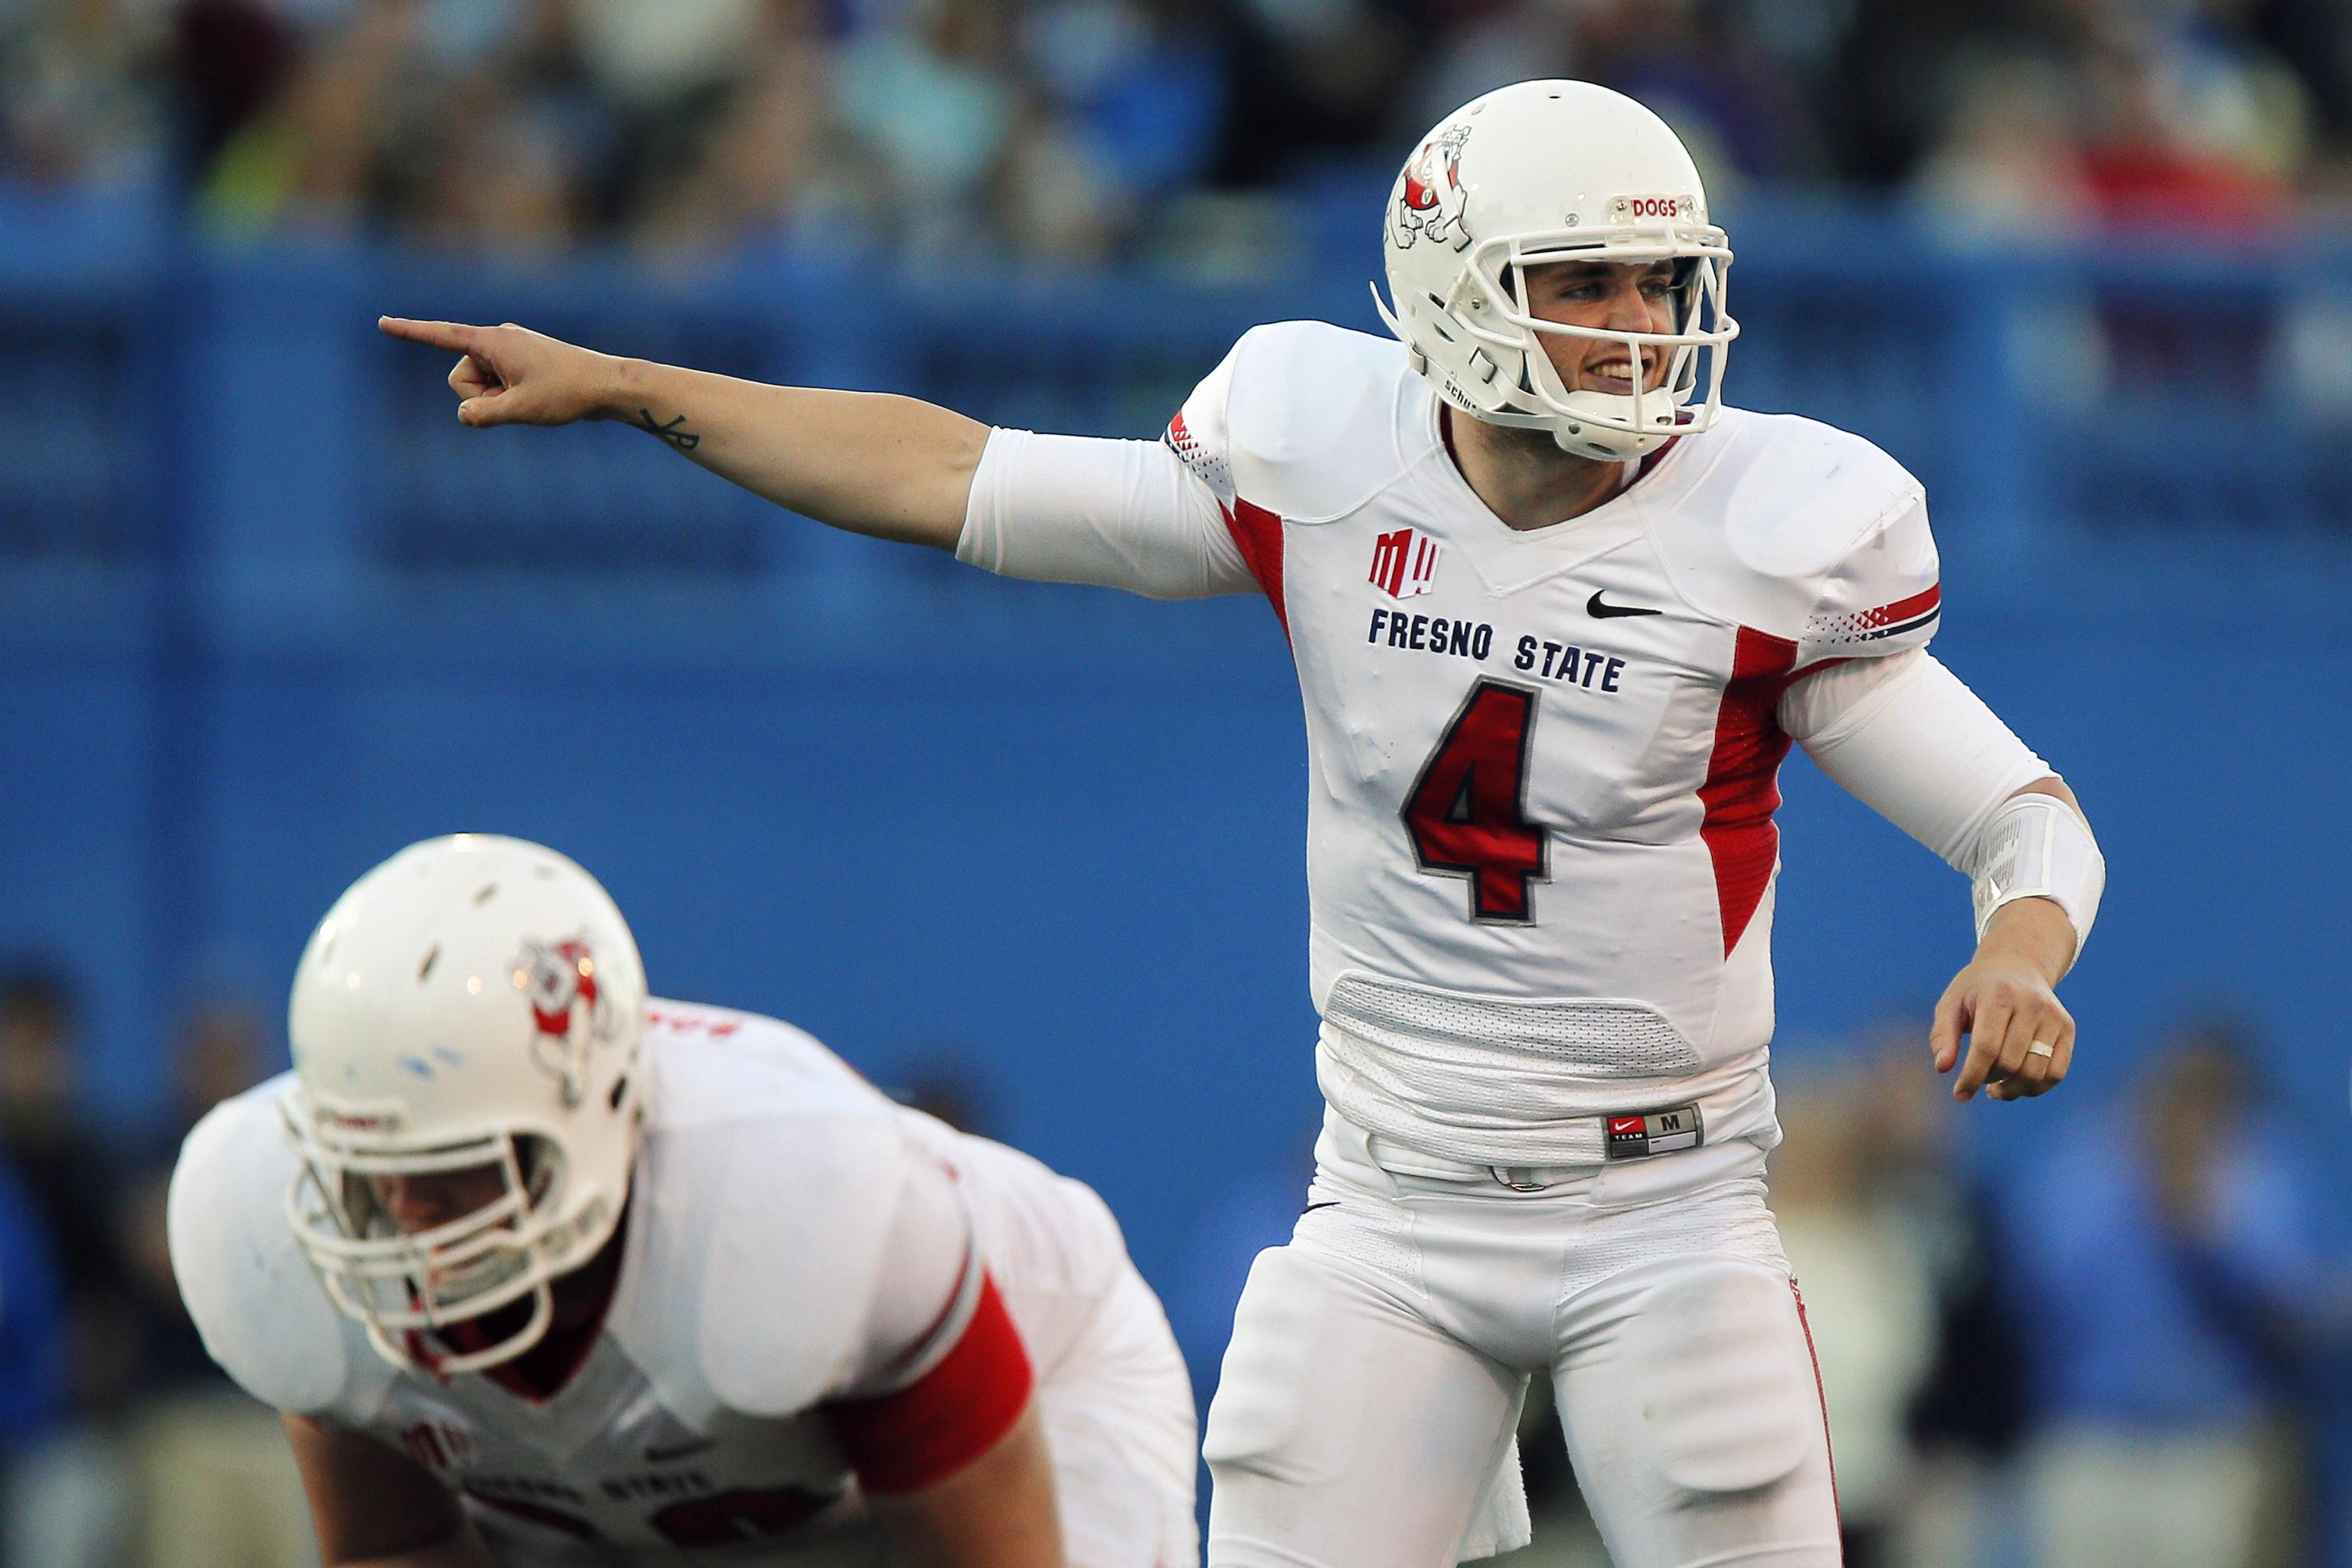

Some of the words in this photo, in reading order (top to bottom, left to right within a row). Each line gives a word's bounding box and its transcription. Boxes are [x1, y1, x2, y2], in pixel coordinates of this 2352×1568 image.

[1369, 609, 1493, 661] FRESNO
[1514, 635, 1625, 692] STATE
[1396, 673, 1553, 927] 4
[1660, 1115, 1681, 1131] M
